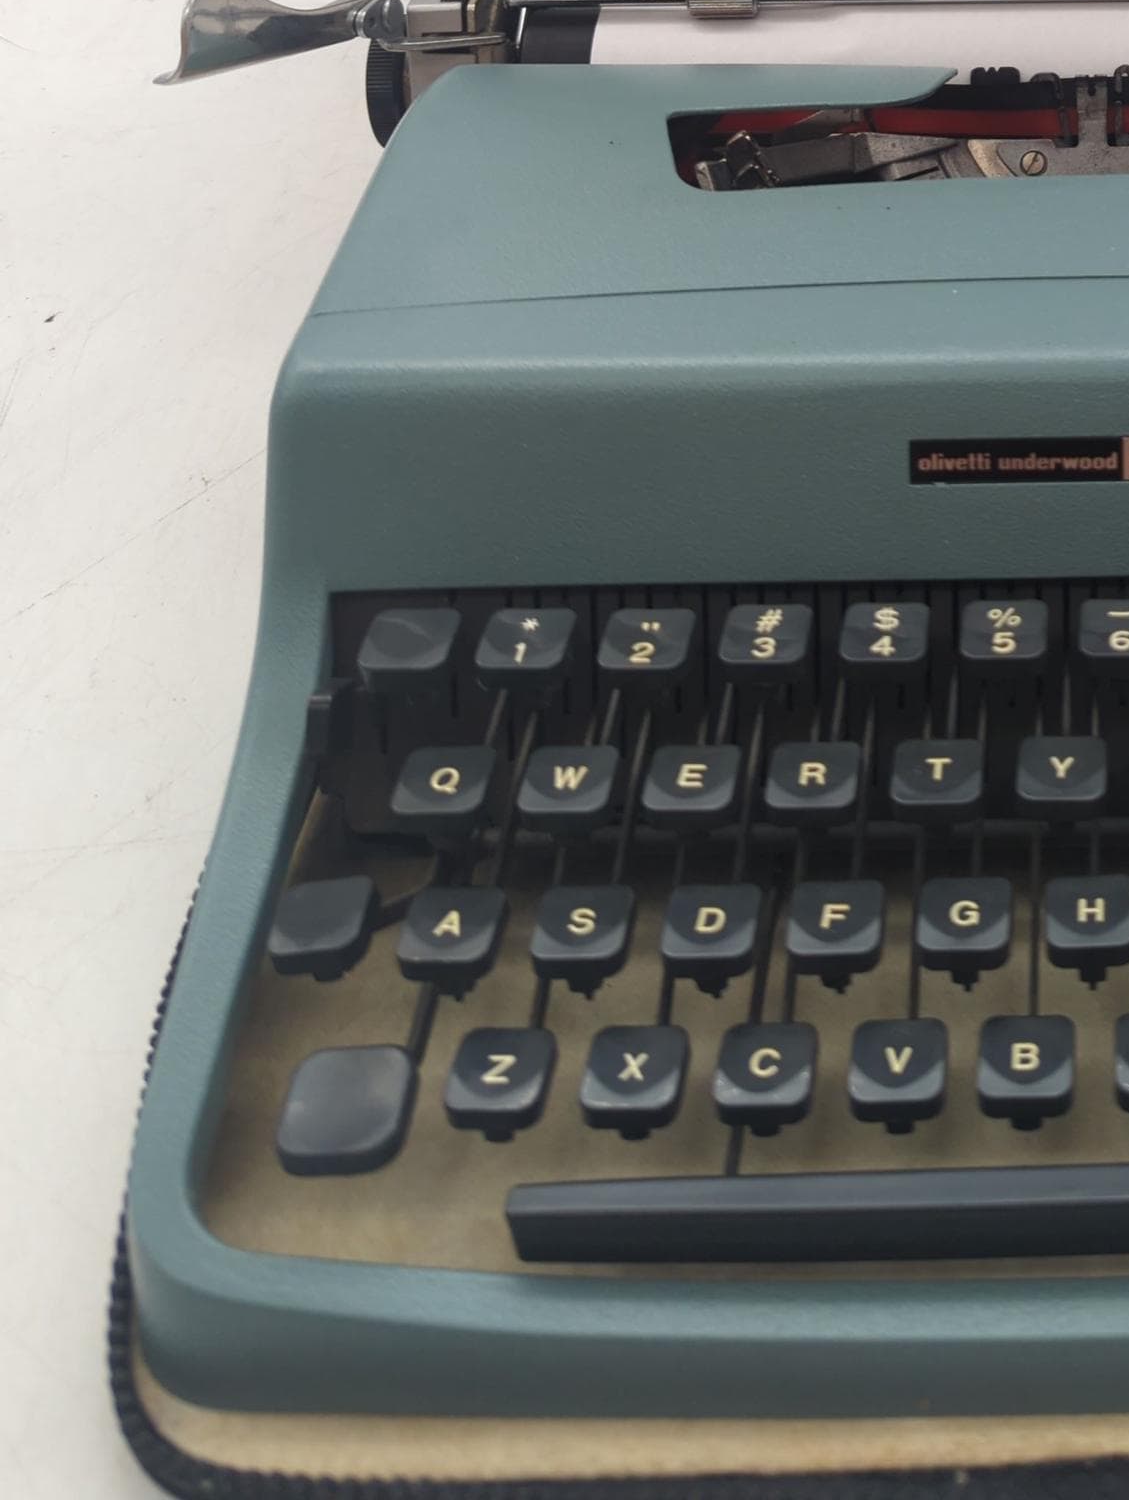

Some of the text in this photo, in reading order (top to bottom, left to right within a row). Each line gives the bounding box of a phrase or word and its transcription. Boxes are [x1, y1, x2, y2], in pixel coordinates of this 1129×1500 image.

[917, 452, 992, 472] olivetti
[997, 450, 1118, 472] underwood
[755, 608, 783, 633] #
[874, 607, 899, 631] $
[986, 607, 1022, 628] %
[514, 642, 527, 664] 1
[629, 641, 656, 664] 2
[751, 636, 777, 658] 3
[869, 635, 896, 656] 4
[991, 631, 1017, 654] 5
[429, 766, 460, 794] Q
[553, 765, 588, 790] W
[676, 763, 708, 788] E
[798, 761, 827, 785] R
[926, 757, 953, 781] T
[1049, 756, 1075, 779] Y
[567, 907, 597, 935] S
[694, 906, 726, 934] D
[819, 903, 851, 929] F
[949, 900, 981, 927] G
[1076, 897, 1106, 923] H
[432, 909, 462, 937] A
[481, 1053, 517, 1084] Z
[621, 1052, 649, 1081] X
[748, 1047, 782, 1077] C
[885, 1046, 913, 1074] V
[1010, 1042, 1040, 1071] B
